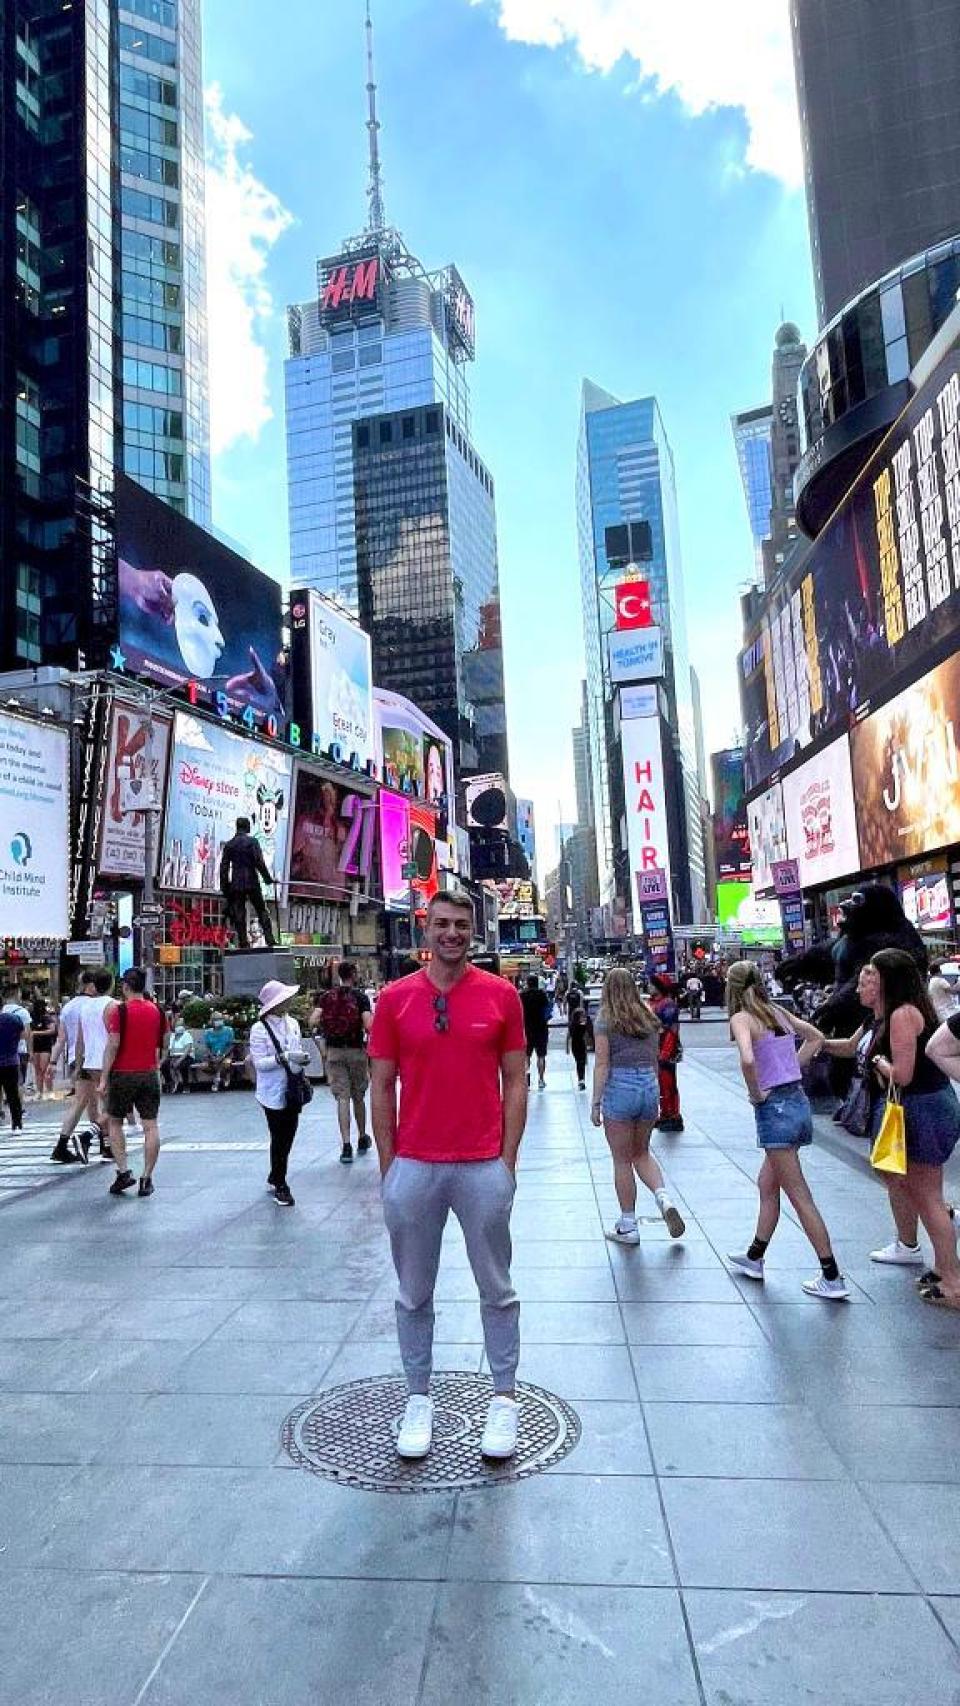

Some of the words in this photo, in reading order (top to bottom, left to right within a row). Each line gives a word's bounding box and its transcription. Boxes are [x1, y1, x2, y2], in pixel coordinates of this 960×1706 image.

[215, 780, 240, 798] store
[634, 760, 659, 870] HAIR
[24, 872, 46, 884] Mind
[3, 883, 41, 897] Institute
